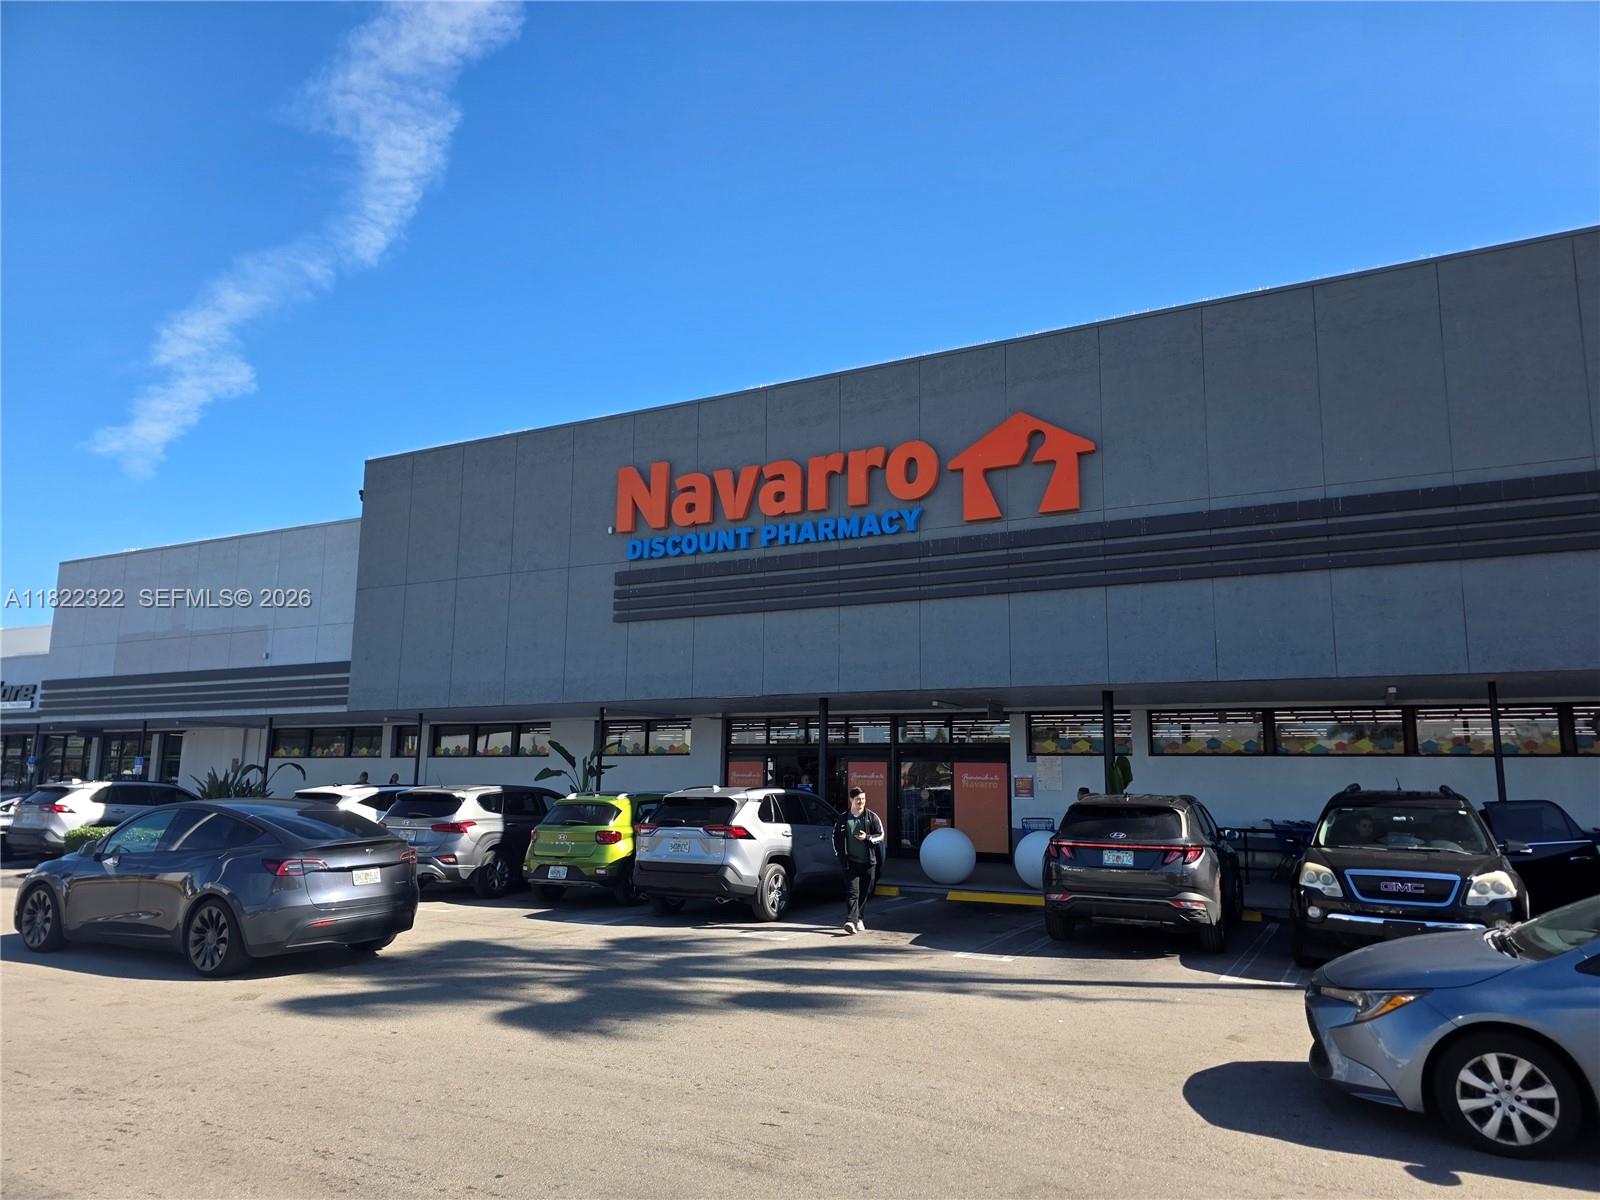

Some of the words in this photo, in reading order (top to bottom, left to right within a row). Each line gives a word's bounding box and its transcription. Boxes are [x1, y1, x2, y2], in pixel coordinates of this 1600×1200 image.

[615, 439, 940, 534] Navarro
[626, 527, 754, 560] DISCOUNT
[760, 507, 924, 547] PHARMACY
[1381, 882, 1425, 894] GMC
